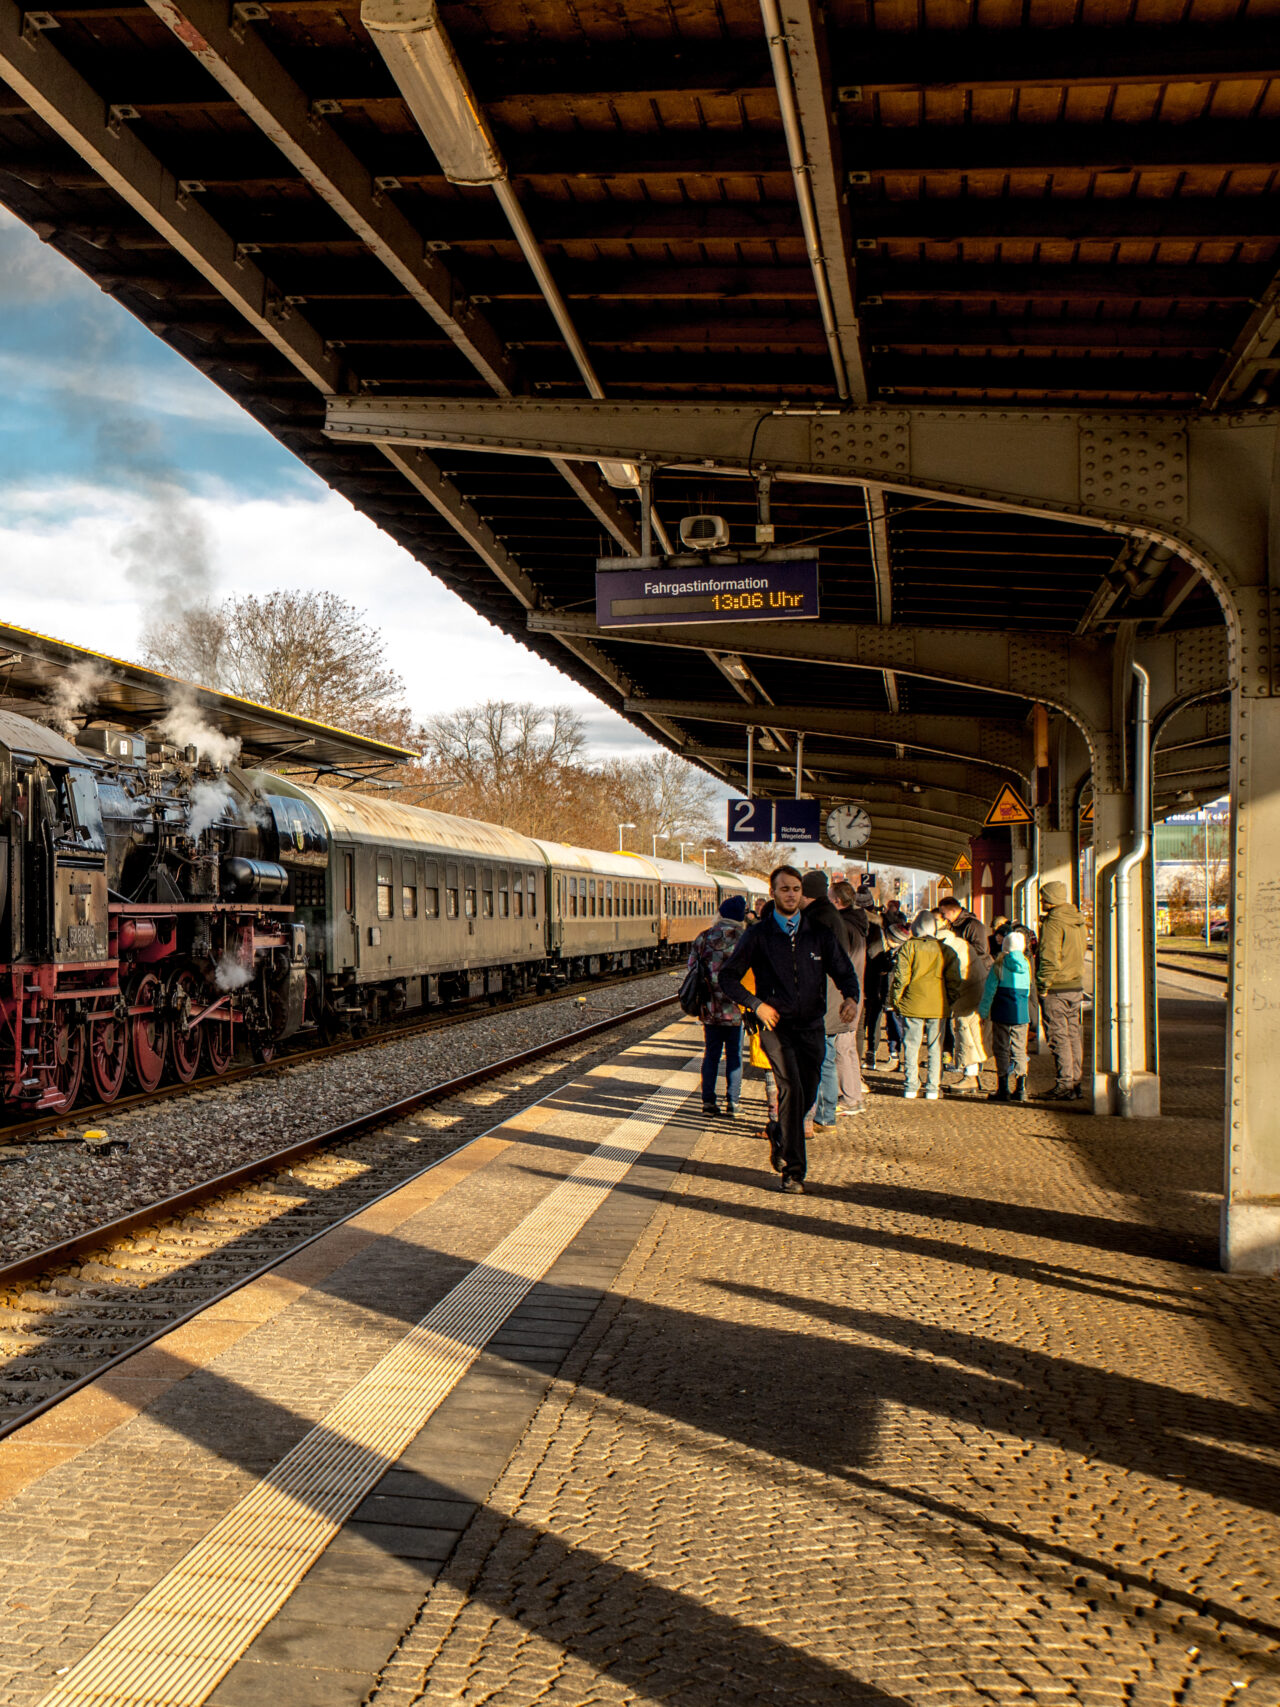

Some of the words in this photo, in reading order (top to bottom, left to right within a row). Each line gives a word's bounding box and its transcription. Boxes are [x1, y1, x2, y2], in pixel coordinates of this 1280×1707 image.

[644, 577, 768, 595] Fahrgastinformation
[711, 592, 763, 610] 13:06
[769, 590, 804, 608] Uhr
[734, 801, 755, 832] 2
[781, 826, 806, 834] Richtung
[862, 874, 870, 885] 2
